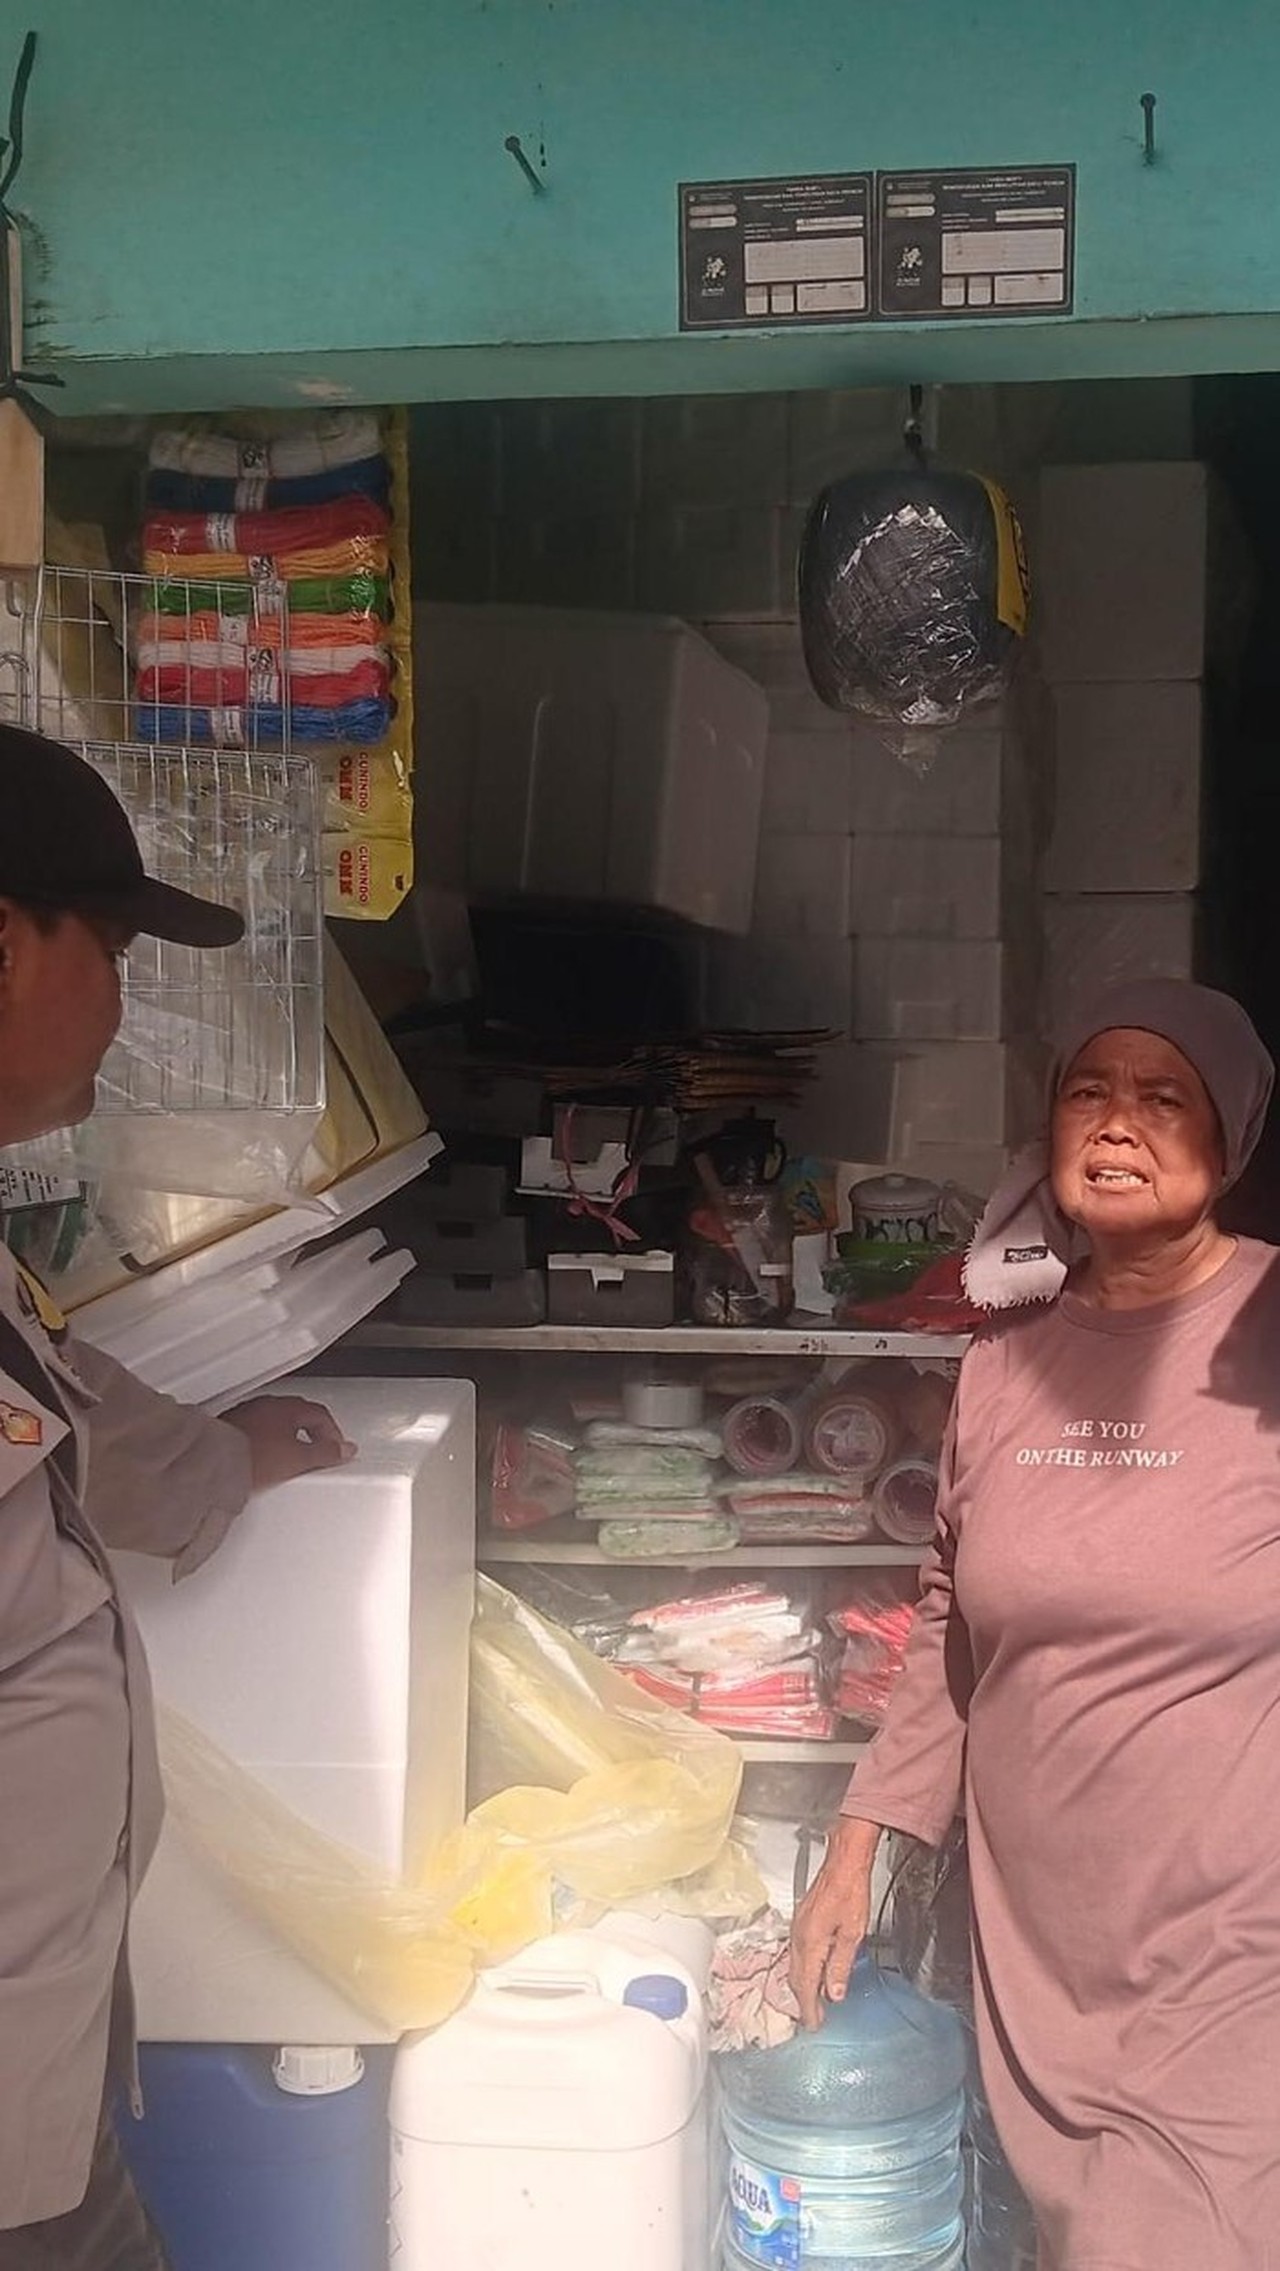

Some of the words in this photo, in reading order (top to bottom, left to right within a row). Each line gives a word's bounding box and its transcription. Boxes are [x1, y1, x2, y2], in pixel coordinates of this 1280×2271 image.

[1061, 1420, 1094, 1438] SEE
[1100, 1422, 1147, 1439] YOU
[1089, 1449, 1184, 1468] RUNWAY
[731, 2167, 773, 2215] AQUA
